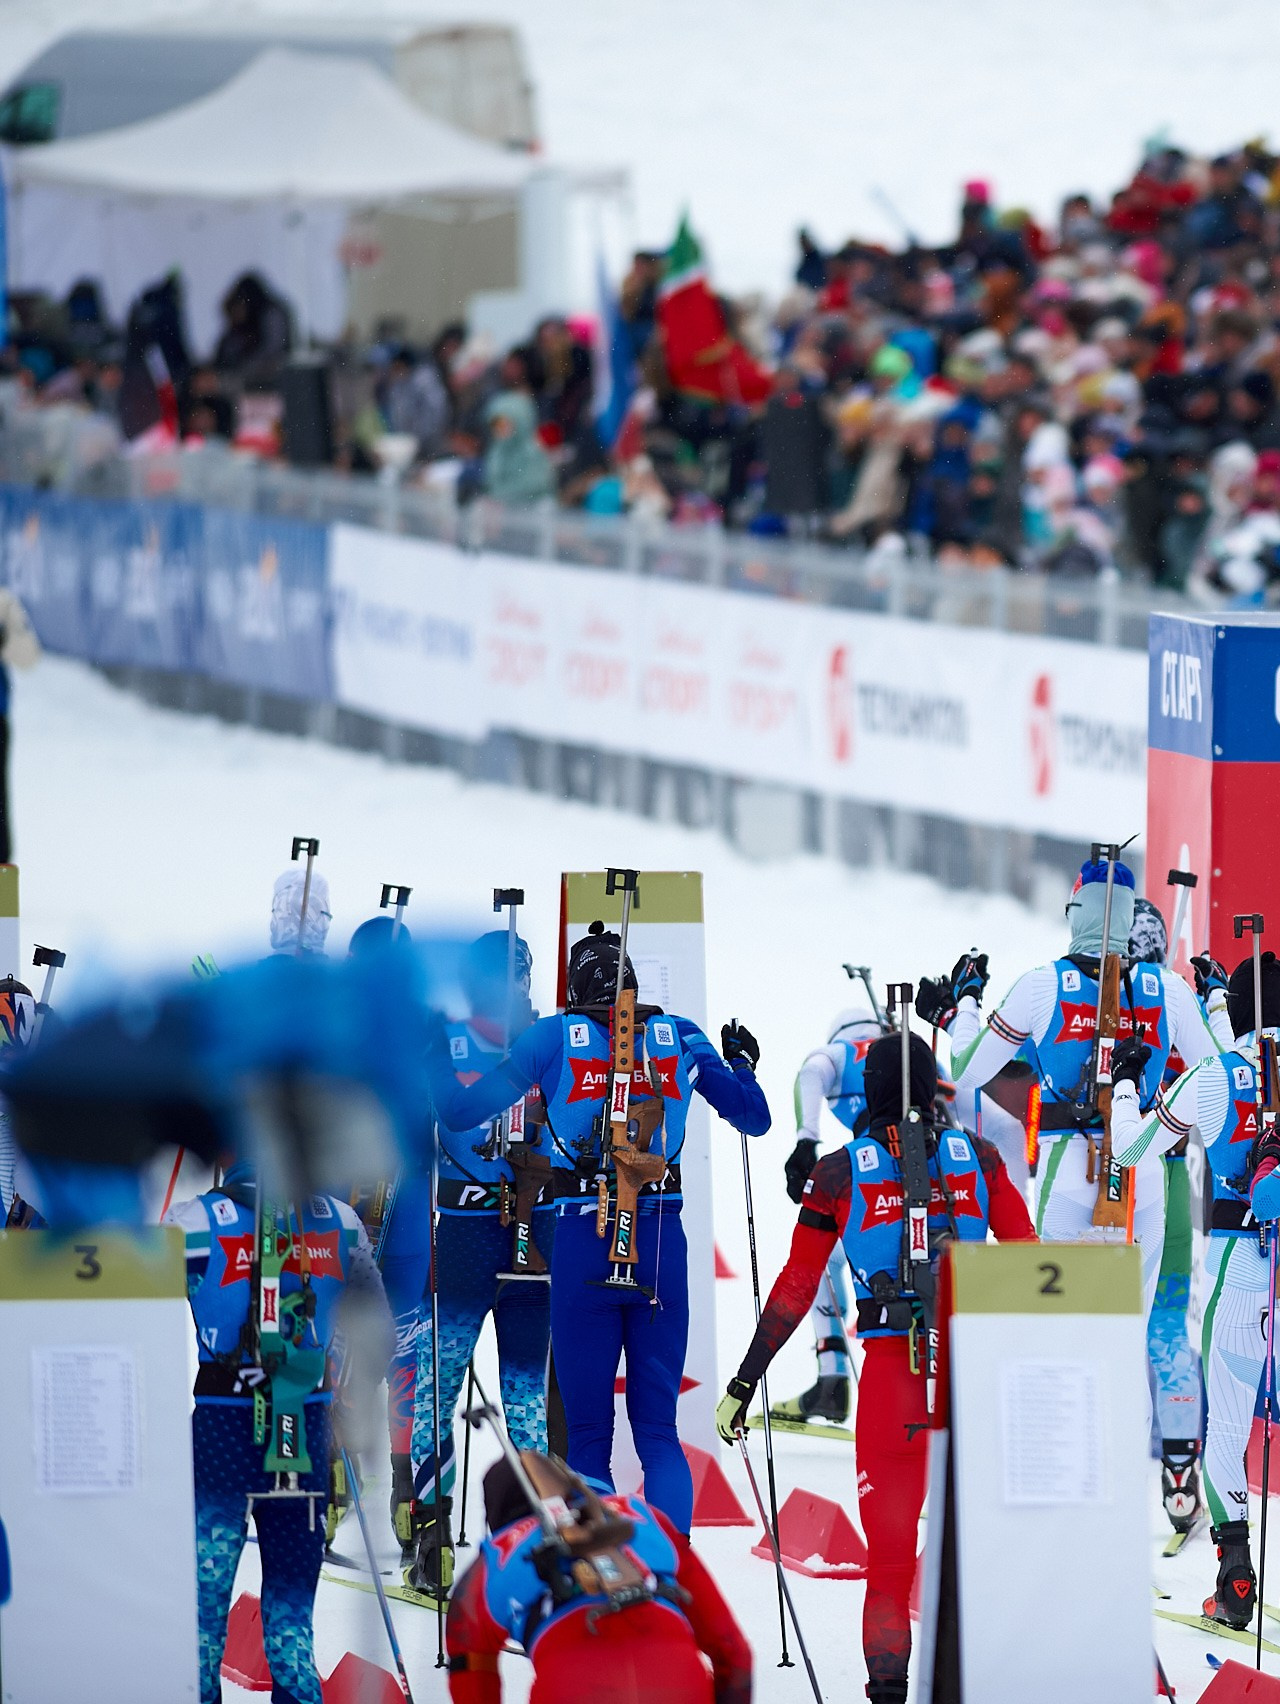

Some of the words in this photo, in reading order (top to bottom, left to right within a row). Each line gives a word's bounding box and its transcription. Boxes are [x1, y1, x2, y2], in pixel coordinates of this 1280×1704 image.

[1161, 649, 1202, 723] СТАРТ
[1071, 1014, 1097, 1028] Аль
[582, 1071, 608, 1084] Аль
[875, 1193, 904, 1210] Аль
[518, 1222, 529, 1265] PARI
[616, 1211, 631, 1256] PARI
[75, 1245, 101, 1280] 3
[1037, 1263, 1063, 1296] 2
[282, 1415, 294, 1457] PARI
[1201, 1618, 1220, 1631] FISCHER
